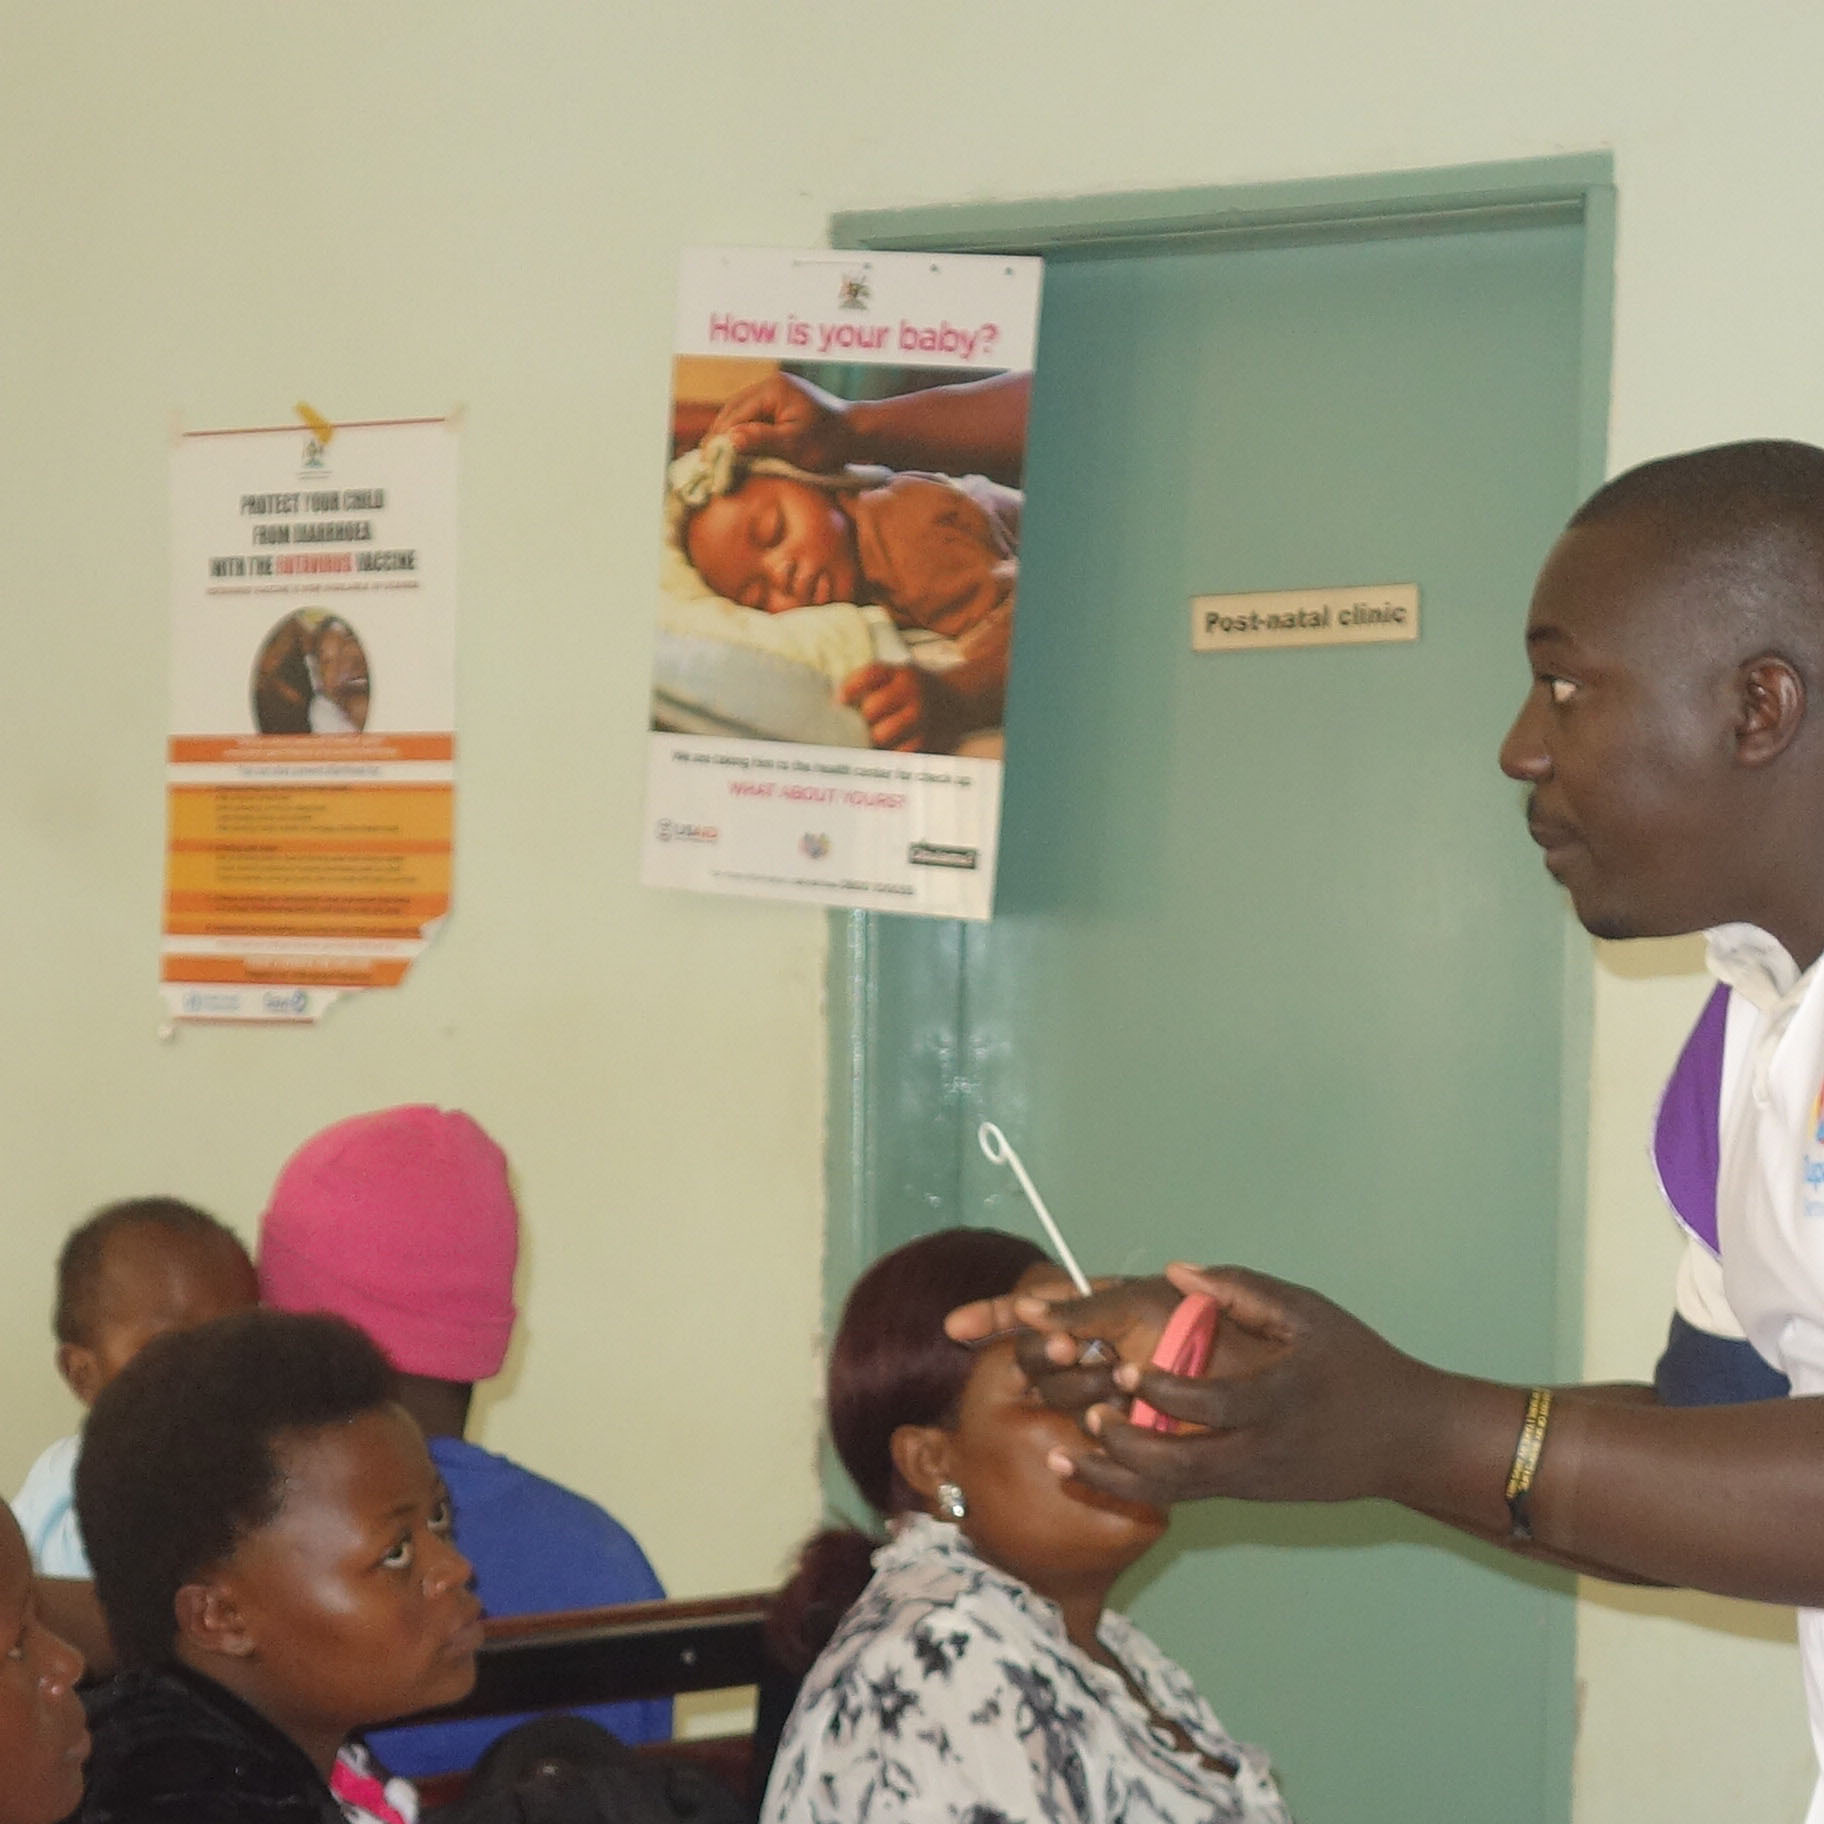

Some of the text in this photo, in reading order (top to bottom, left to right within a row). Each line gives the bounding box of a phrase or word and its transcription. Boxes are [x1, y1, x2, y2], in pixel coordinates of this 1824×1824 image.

[710, 312, 999, 359] How is your baby?
[240, 488, 385, 516] PROTECT YOUR CHILD
[252, 523, 290, 545] FROM
[210, 555, 245, 577] WITH
[247, 555, 273, 576] THE
[356, 549, 416, 573] VACCINE
[1204, 602, 1407, 633] Post-natal clinic
[729, 782, 776, 798] WHAT
[780, 785, 837, 804] ABOUT
